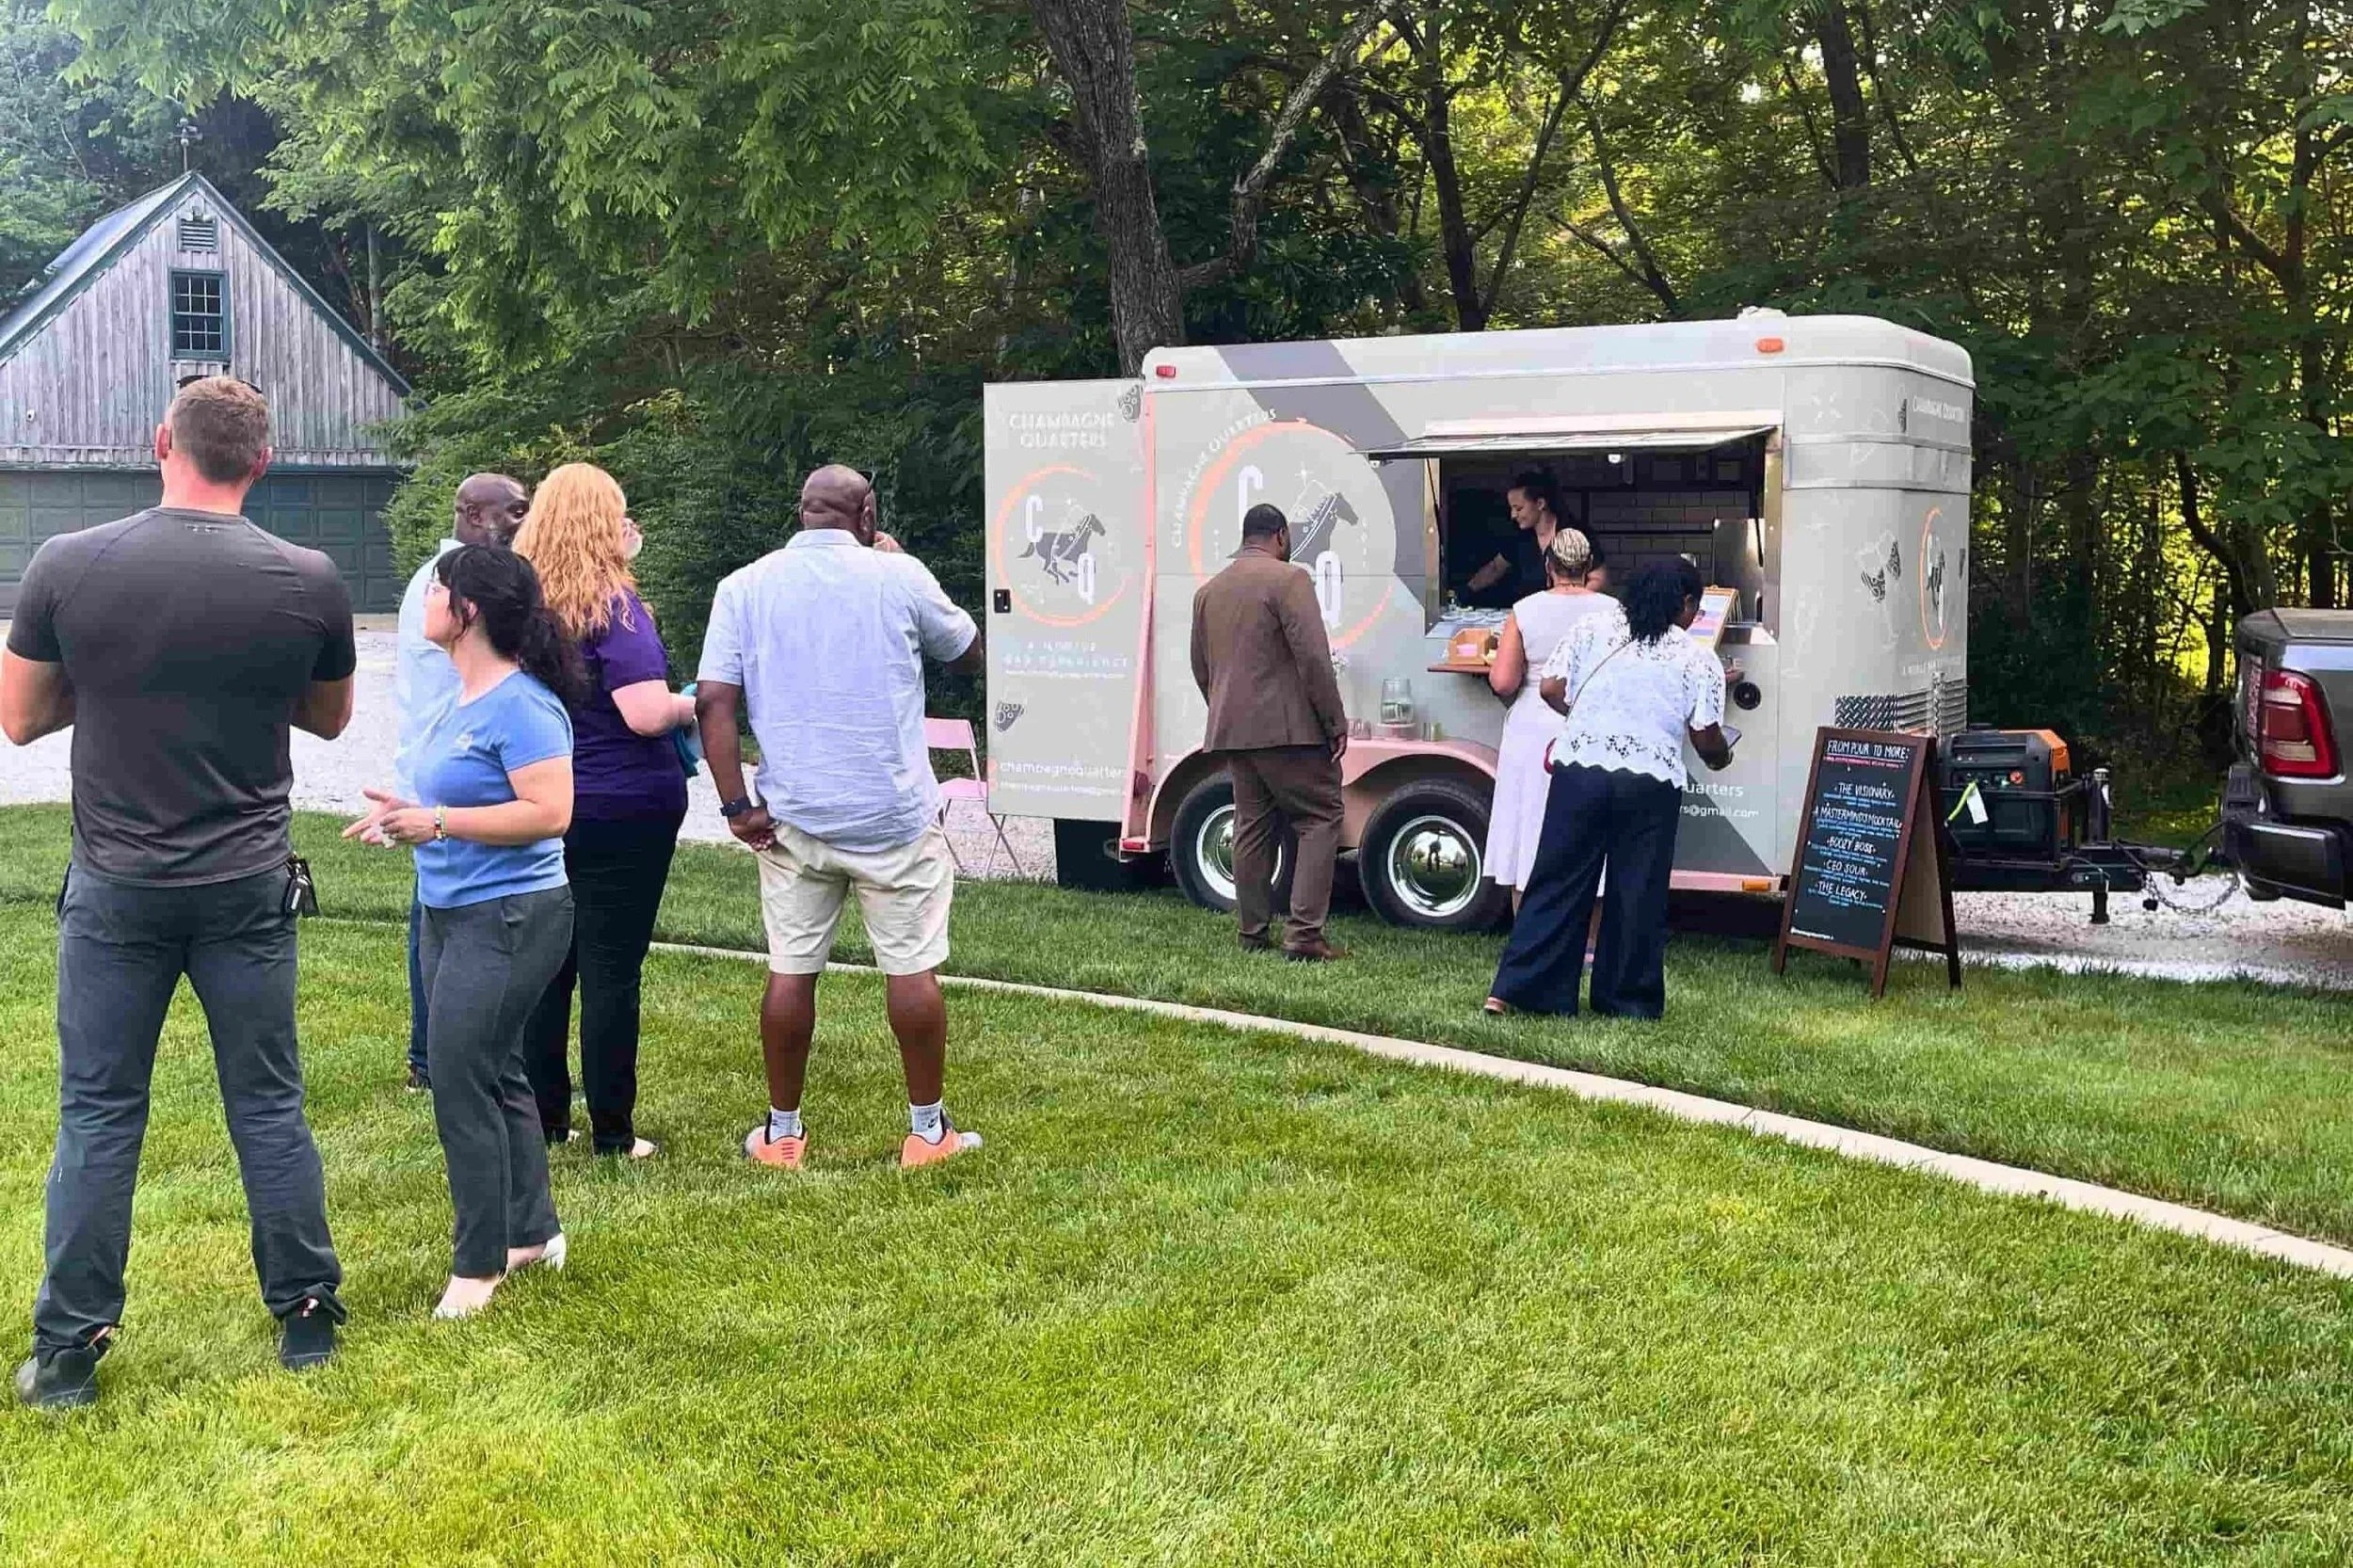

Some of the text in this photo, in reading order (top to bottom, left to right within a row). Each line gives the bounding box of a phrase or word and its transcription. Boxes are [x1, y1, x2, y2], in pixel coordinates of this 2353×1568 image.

[1009, 412, 1114, 429] CHAMPAGNE
[1020, 431, 1106, 449] QUARTERS
[1827, 740, 1849, 754] FROM
[1850, 742, 1869, 756] POUR
[1872, 744, 1881, 758] TO
[1838, 782, 1853, 795] THE
[1826, 859, 1842, 872] CEO
[1817, 881, 1834, 894] THE
[1835, 885, 1865, 902] LEGACY
